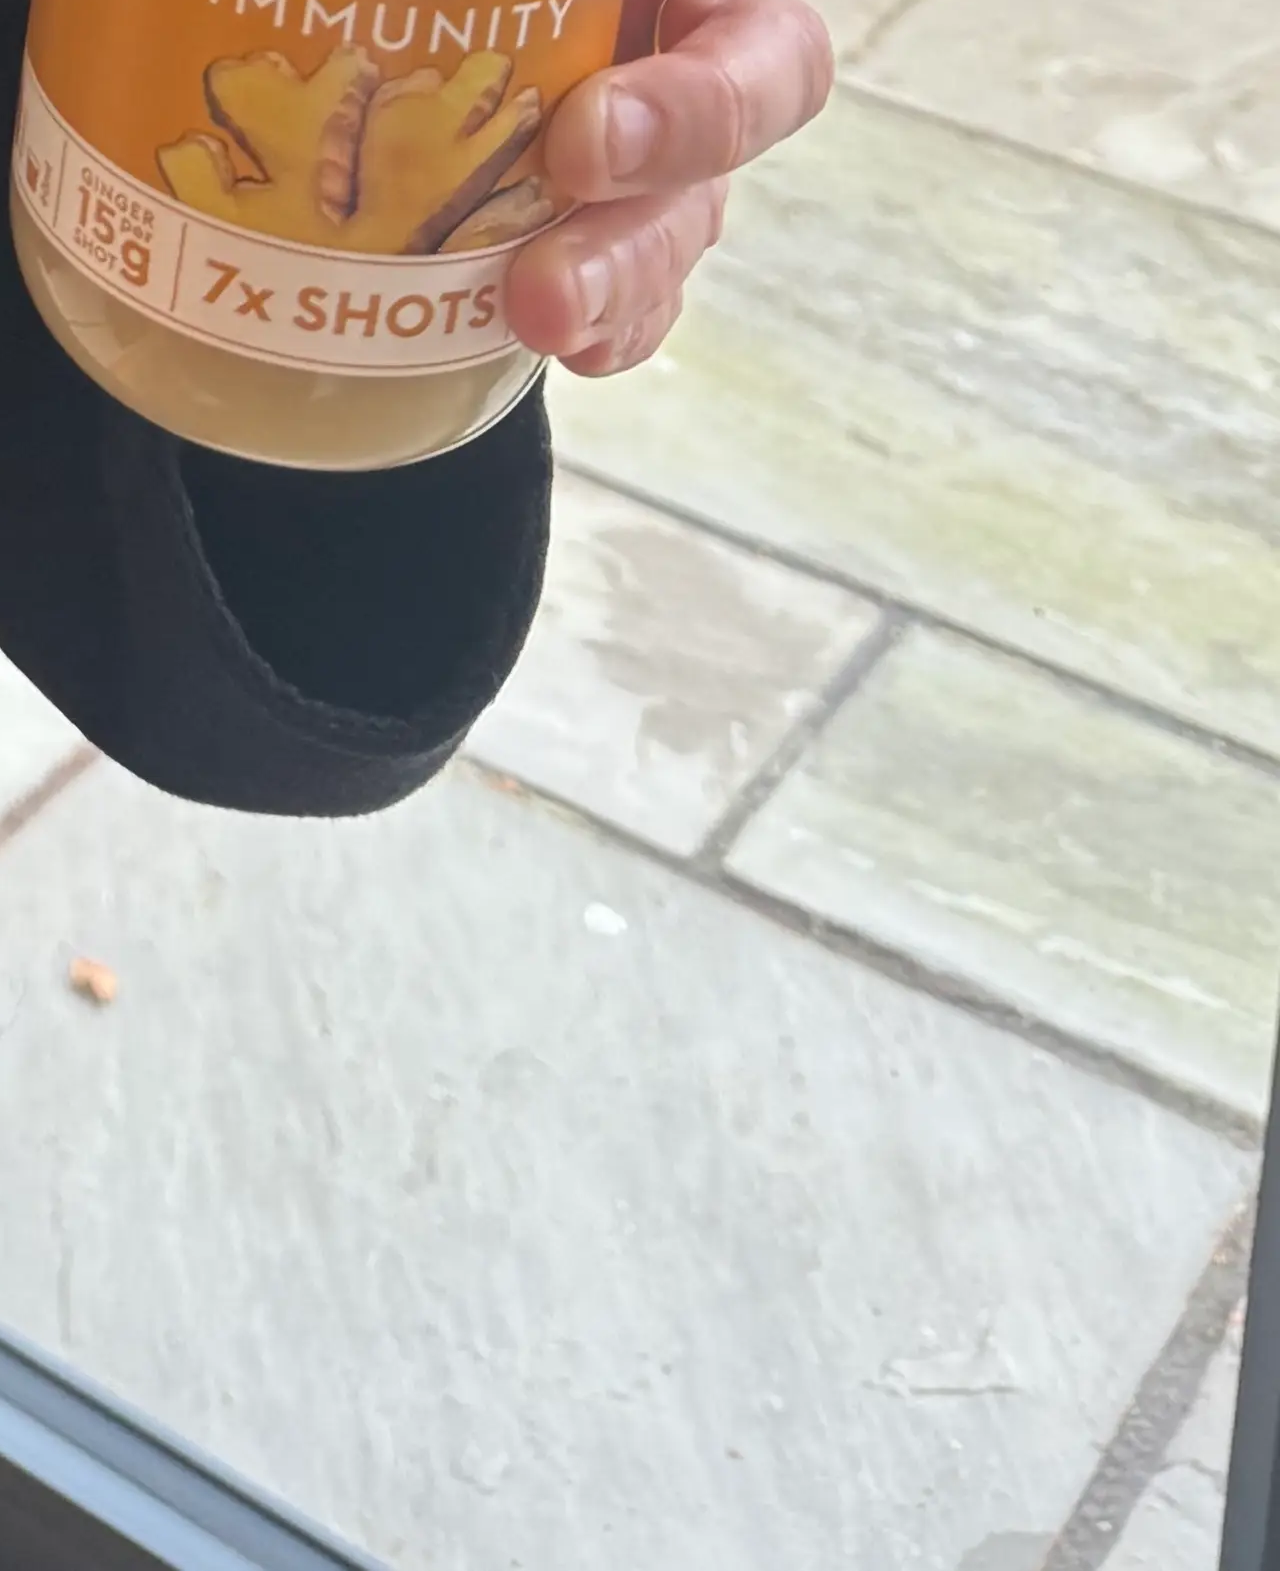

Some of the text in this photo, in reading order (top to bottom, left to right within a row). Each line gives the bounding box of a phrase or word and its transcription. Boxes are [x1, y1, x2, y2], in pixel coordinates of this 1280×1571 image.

[80, 166, 156, 228] GINGER
[71, 226, 118, 271] SHOT
[202, 258, 497, 339] 7x SHOTS
